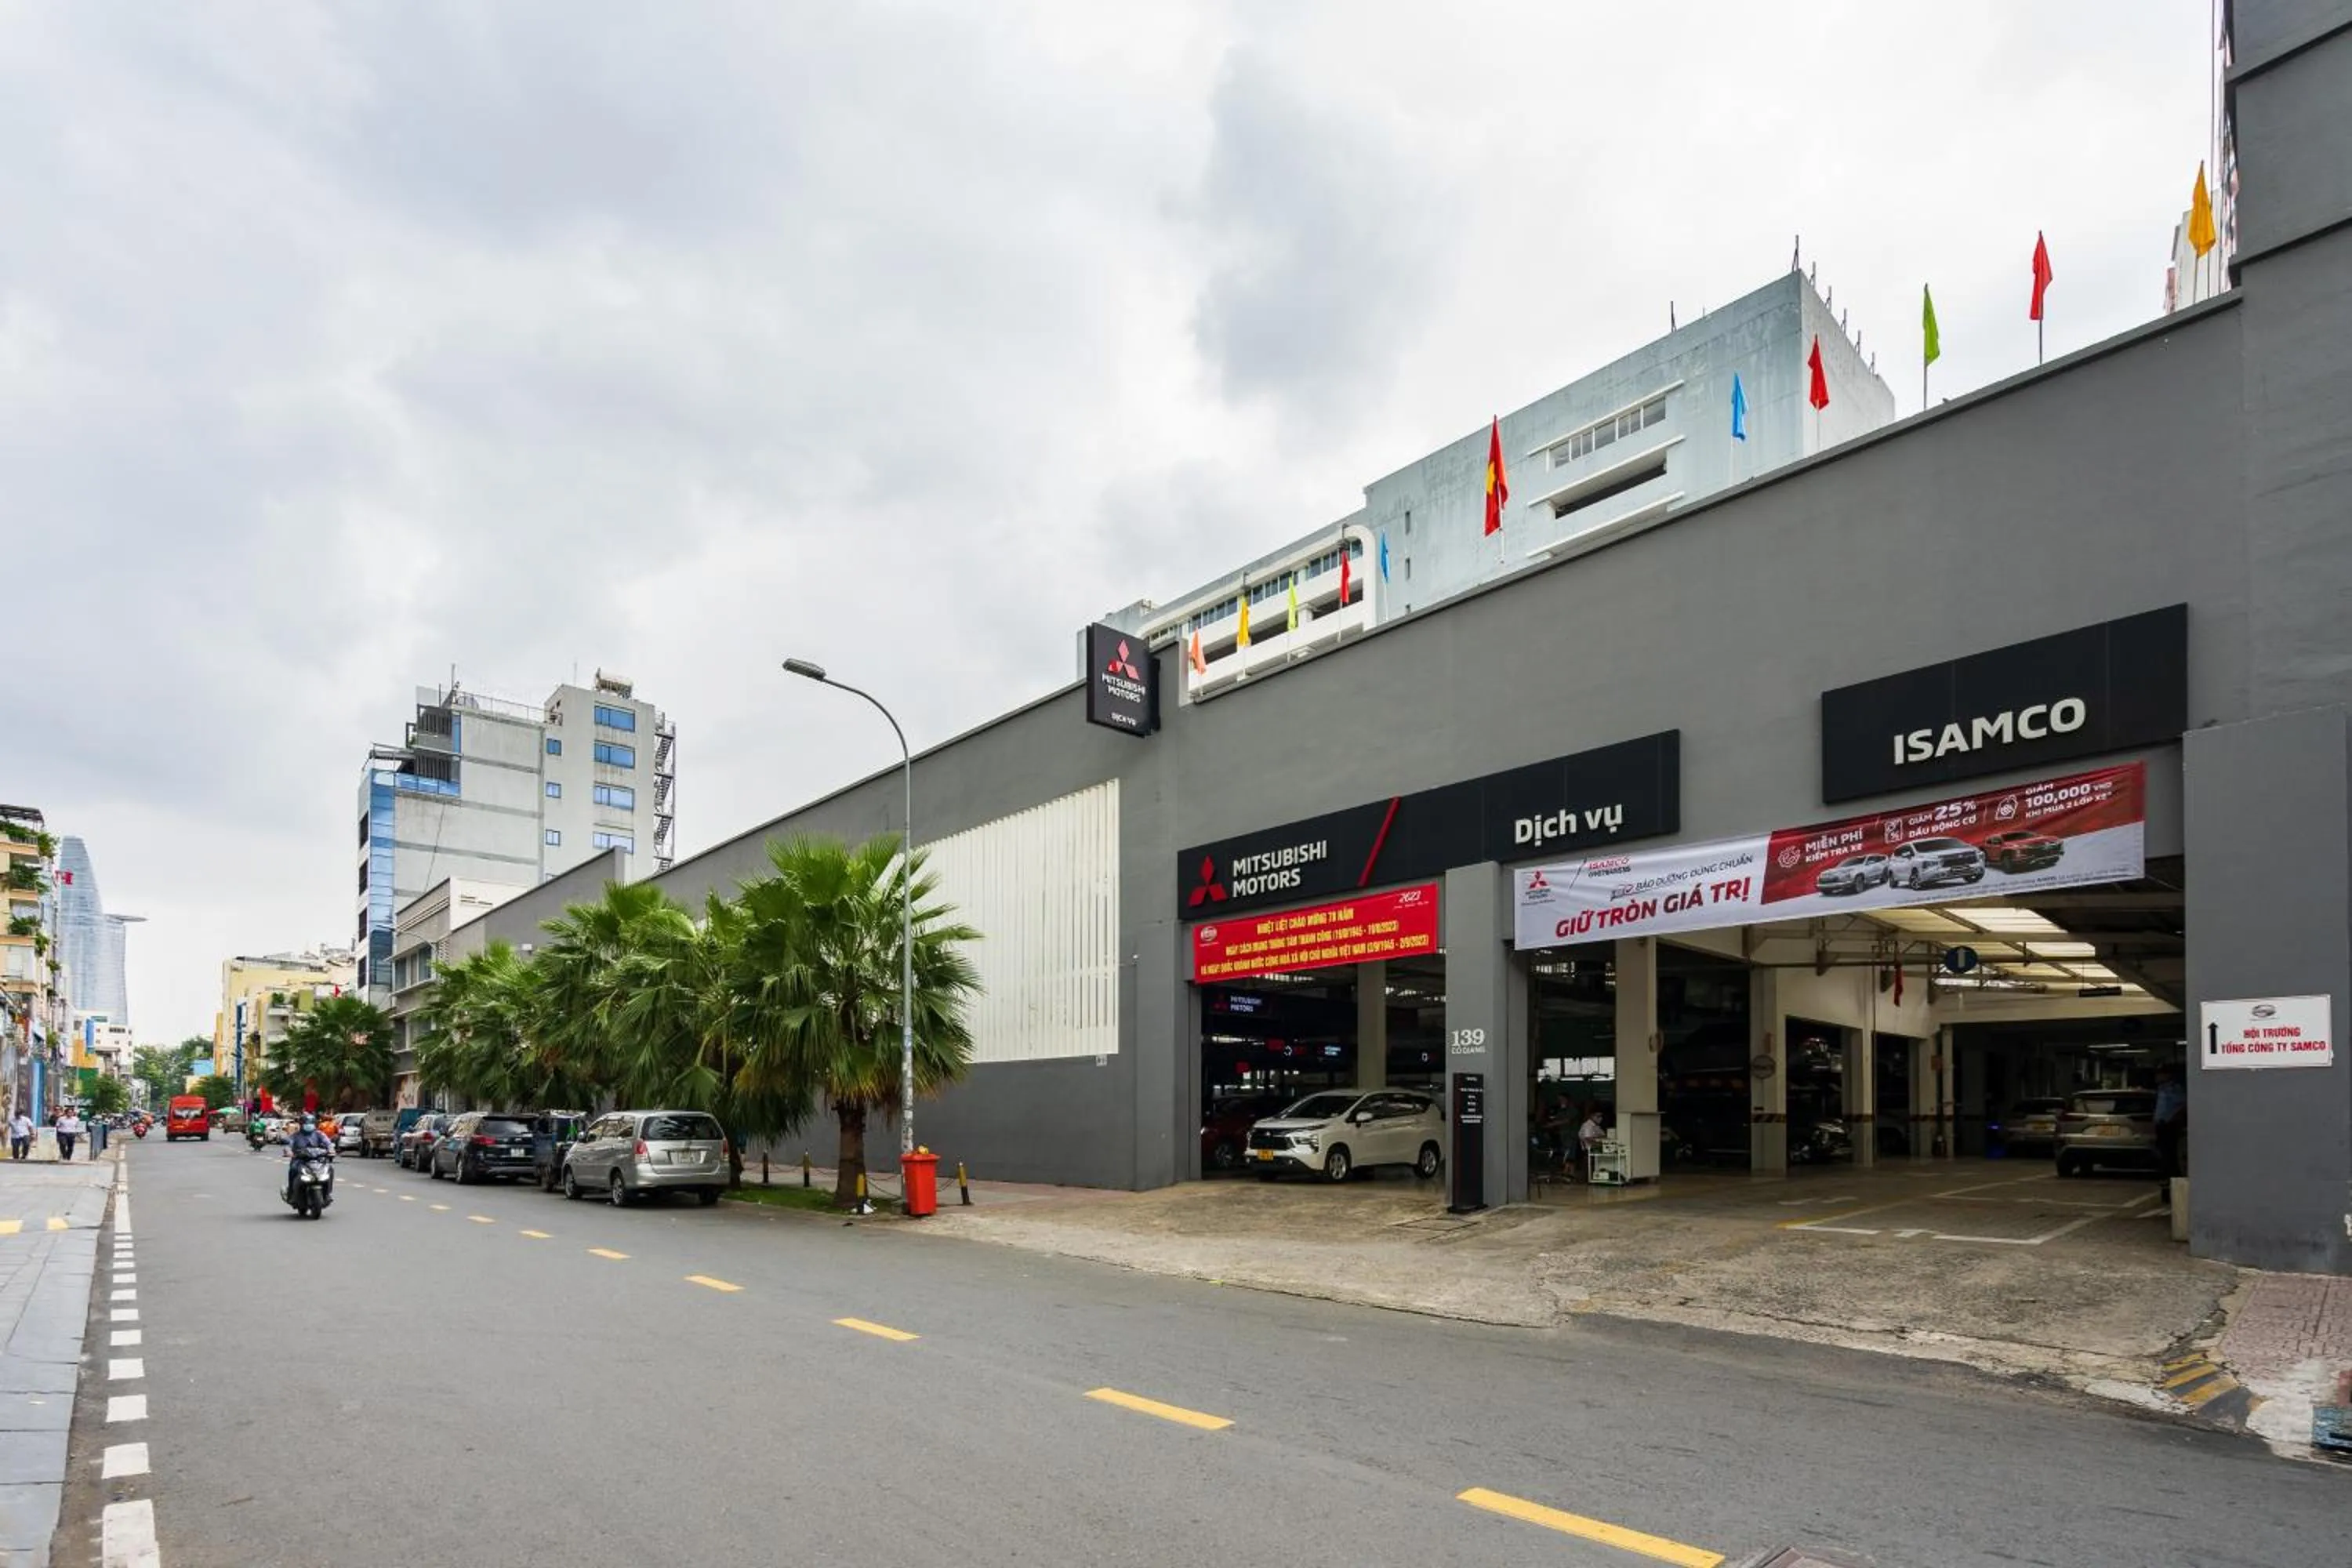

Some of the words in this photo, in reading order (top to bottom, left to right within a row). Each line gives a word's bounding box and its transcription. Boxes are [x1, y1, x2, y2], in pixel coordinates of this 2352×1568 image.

[1102, 673, 1146, 695] MITSUBISHI
[1108, 685, 1142, 703] MOTORS
[1894, 697, 2085, 764] ISAMCO
[2025, 783, 2091, 808] 100,000
[1934, 800, 1976, 821] 25%
[1962, 814, 1976, 825] CƠ
[2025, 808, 2042, 818] KHI
[2043, 804, 2065, 815] MUA
[1515, 809, 1577, 847] Dịch
[1585, 804, 1623, 834] vụ
[1840, 828, 1864, 844] PHÍ
[1232, 840, 1328, 877] MITSUBISHI
[1831, 847, 1849, 857] TRA
[1850, 843, 1864, 852] XE
[1232, 869, 1301, 898] MOTORS
[1555, 909, 1595, 938] GIỮ
[1596, 898, 1657, 928] TRÒN
[1664, 882, 1704, 913] GIÁ
[1451, 1028, 1485, 1047] 139
[2243, 1028, 2259, 1040] HỘI
[2276, 1042, 2288, 1053] TY
[2290, 1040, 2326, 1052] SAMCO
